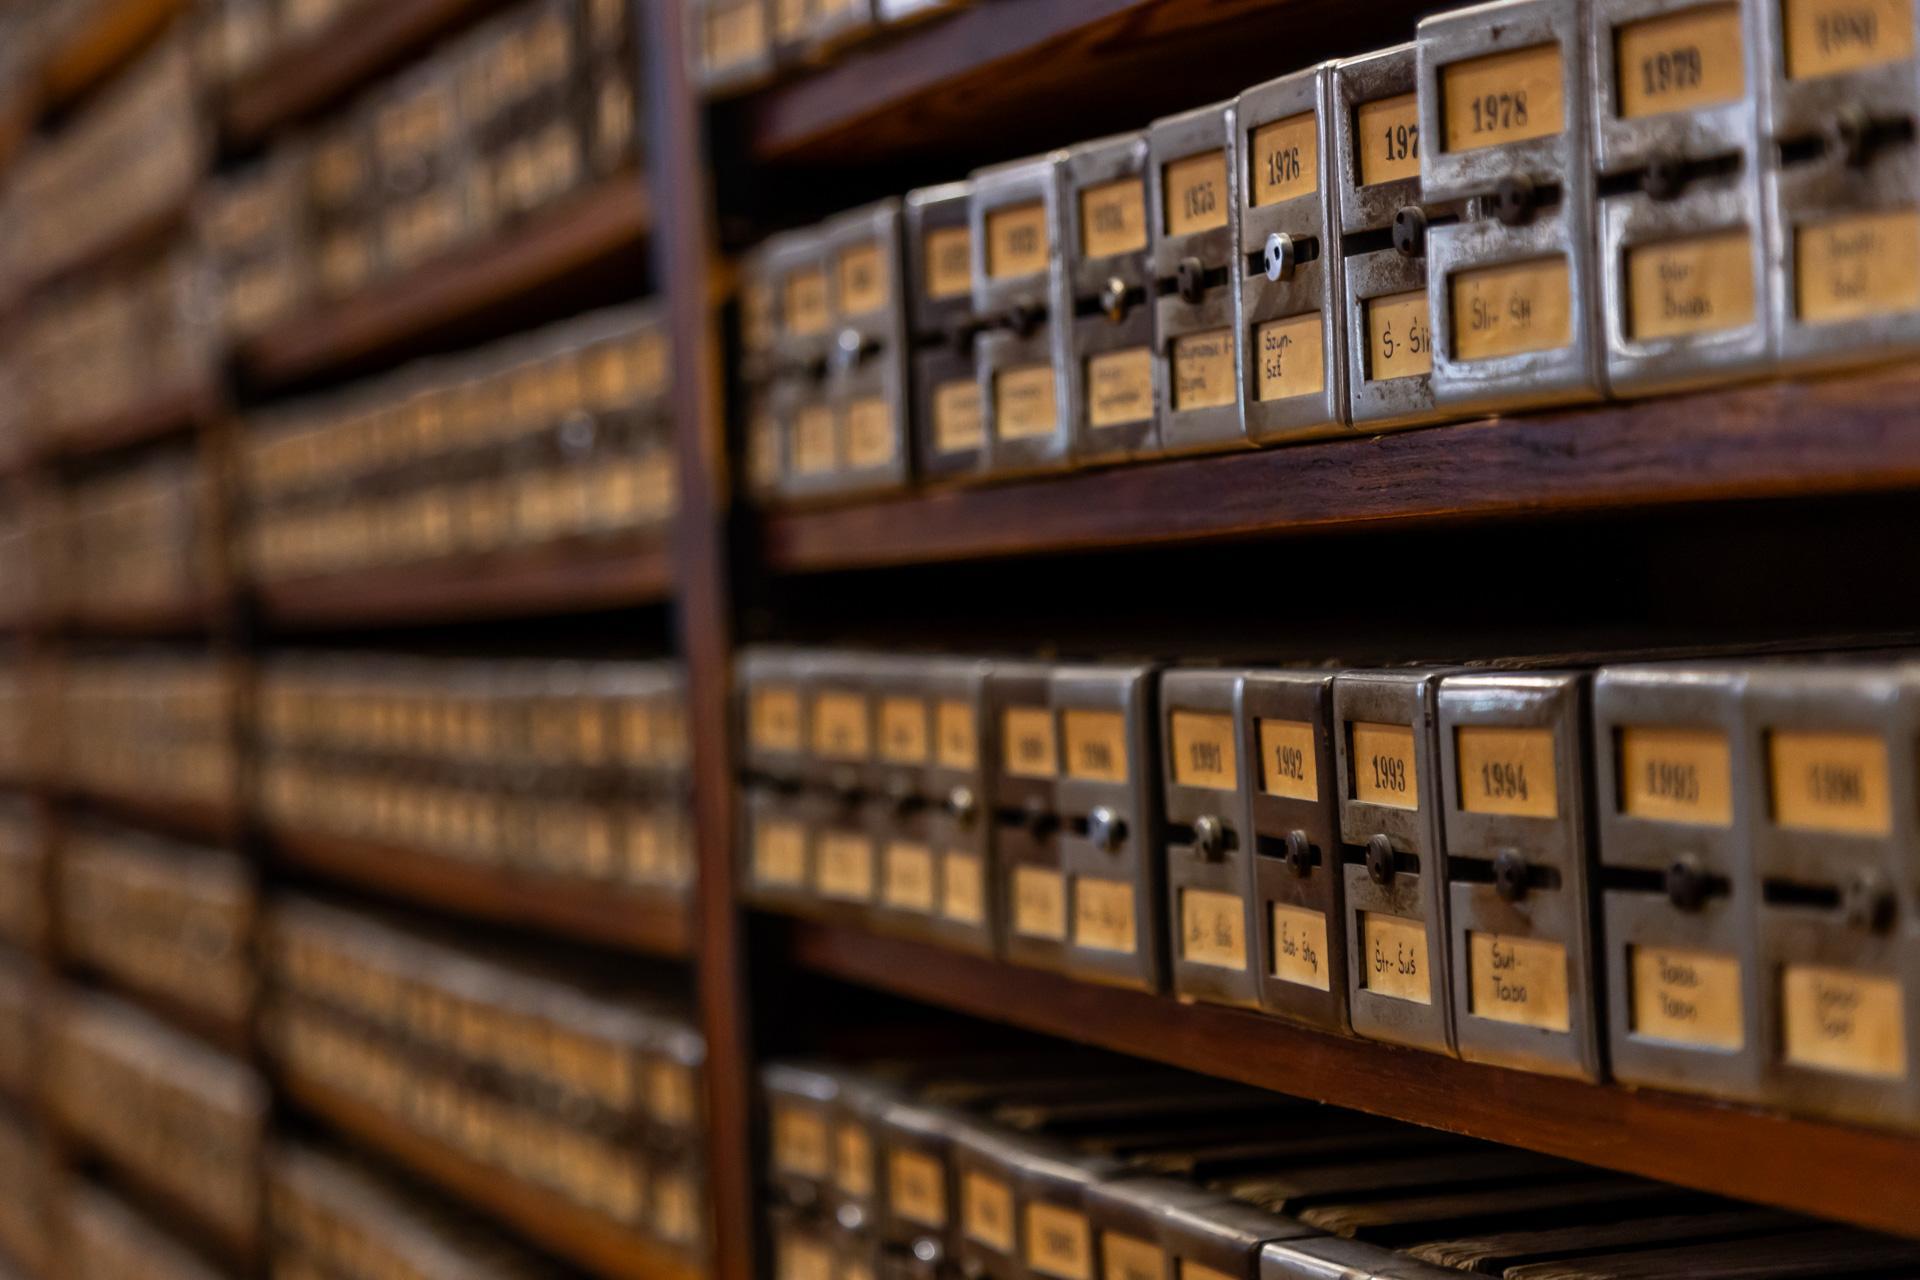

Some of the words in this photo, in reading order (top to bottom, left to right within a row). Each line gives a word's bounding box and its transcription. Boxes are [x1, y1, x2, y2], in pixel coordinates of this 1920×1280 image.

[1472, 90, 1528, 133] 1978
[1385, 124, 1419, 161] 197
[1268, 146, 1300, 186] 1976
[1275, 745, 1304, 781] 1992
[1372, 754, 1406, 793] 1993
[1482, 763, 1528, 801] 1994
